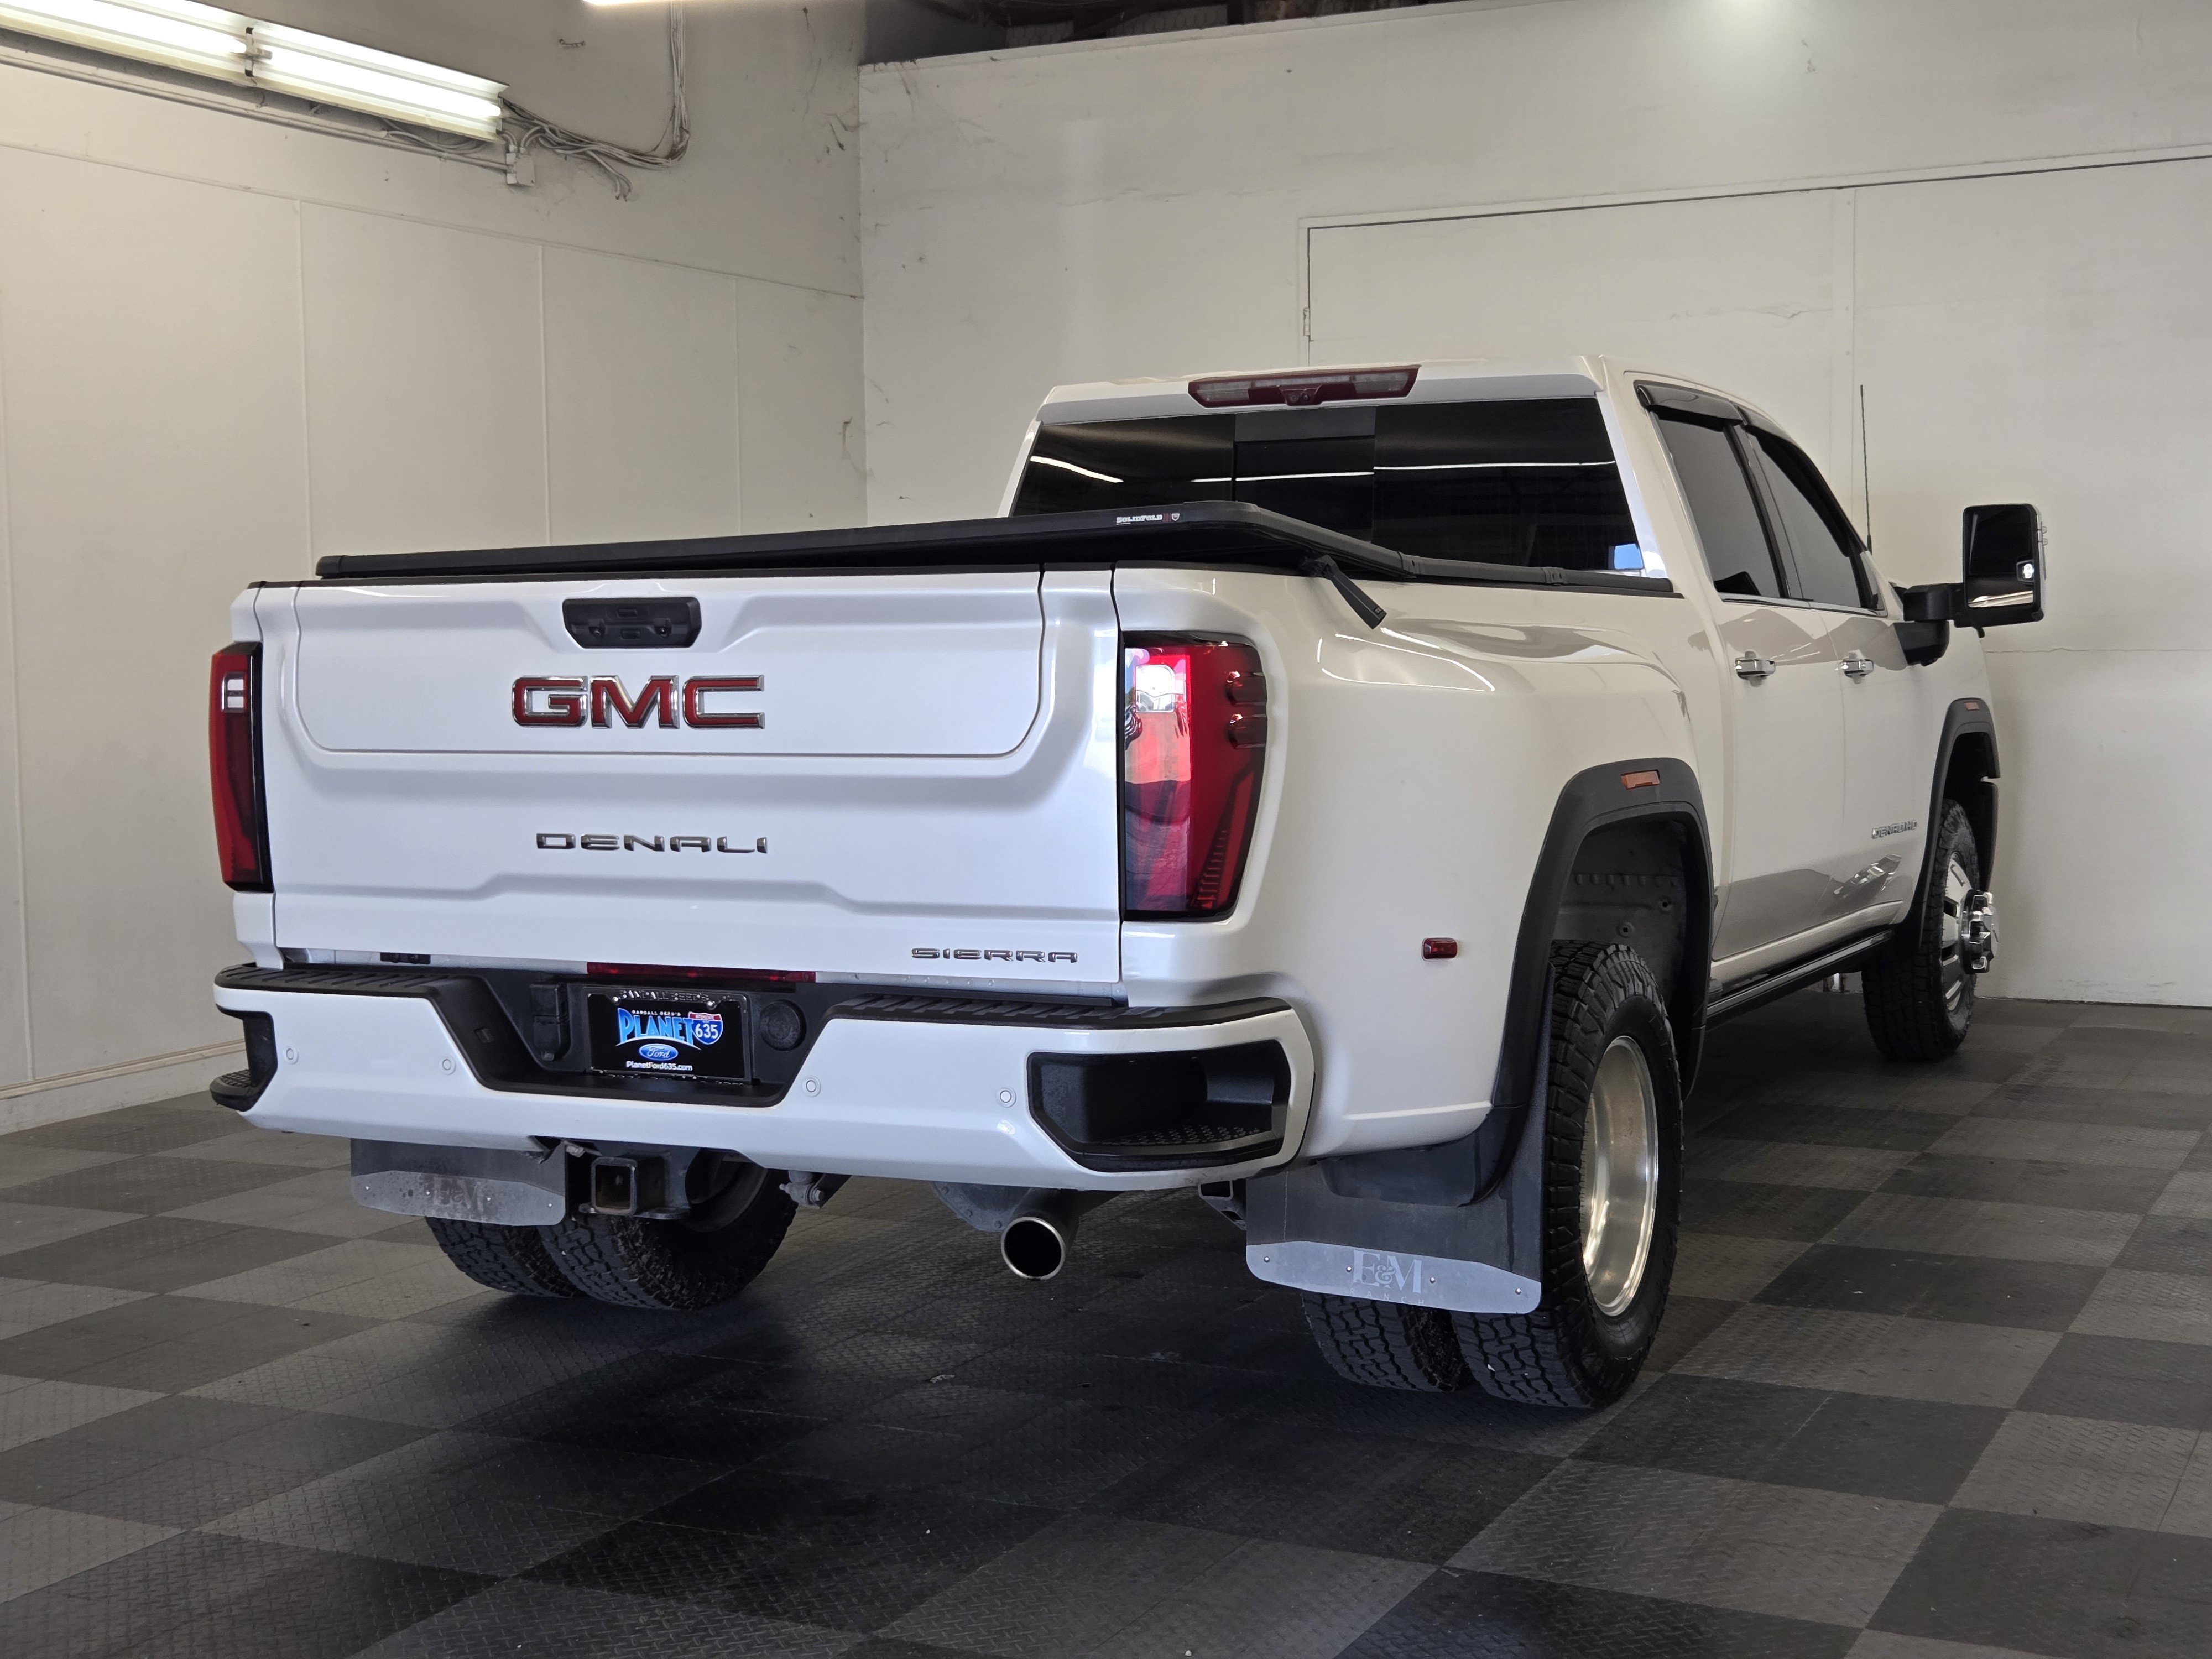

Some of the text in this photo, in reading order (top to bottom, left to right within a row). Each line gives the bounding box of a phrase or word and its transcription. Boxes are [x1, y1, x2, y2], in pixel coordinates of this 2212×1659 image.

[512, 675, 765, 729] GMC
[536, 833, 768, 854] DENALI
[911, 948, 1078, 963] SIERRA
[617, 1007, 694, 1044] PLANET
[695, 1023, 718, 1039] 635
[646, 1046, 671, 1059] Ford
[625, 1060, 693, 1071] PlanetFord635.com
[1353, 1250, 1422, 1294] E&M
[1349, 1287, 1425, 1306] RANCH
